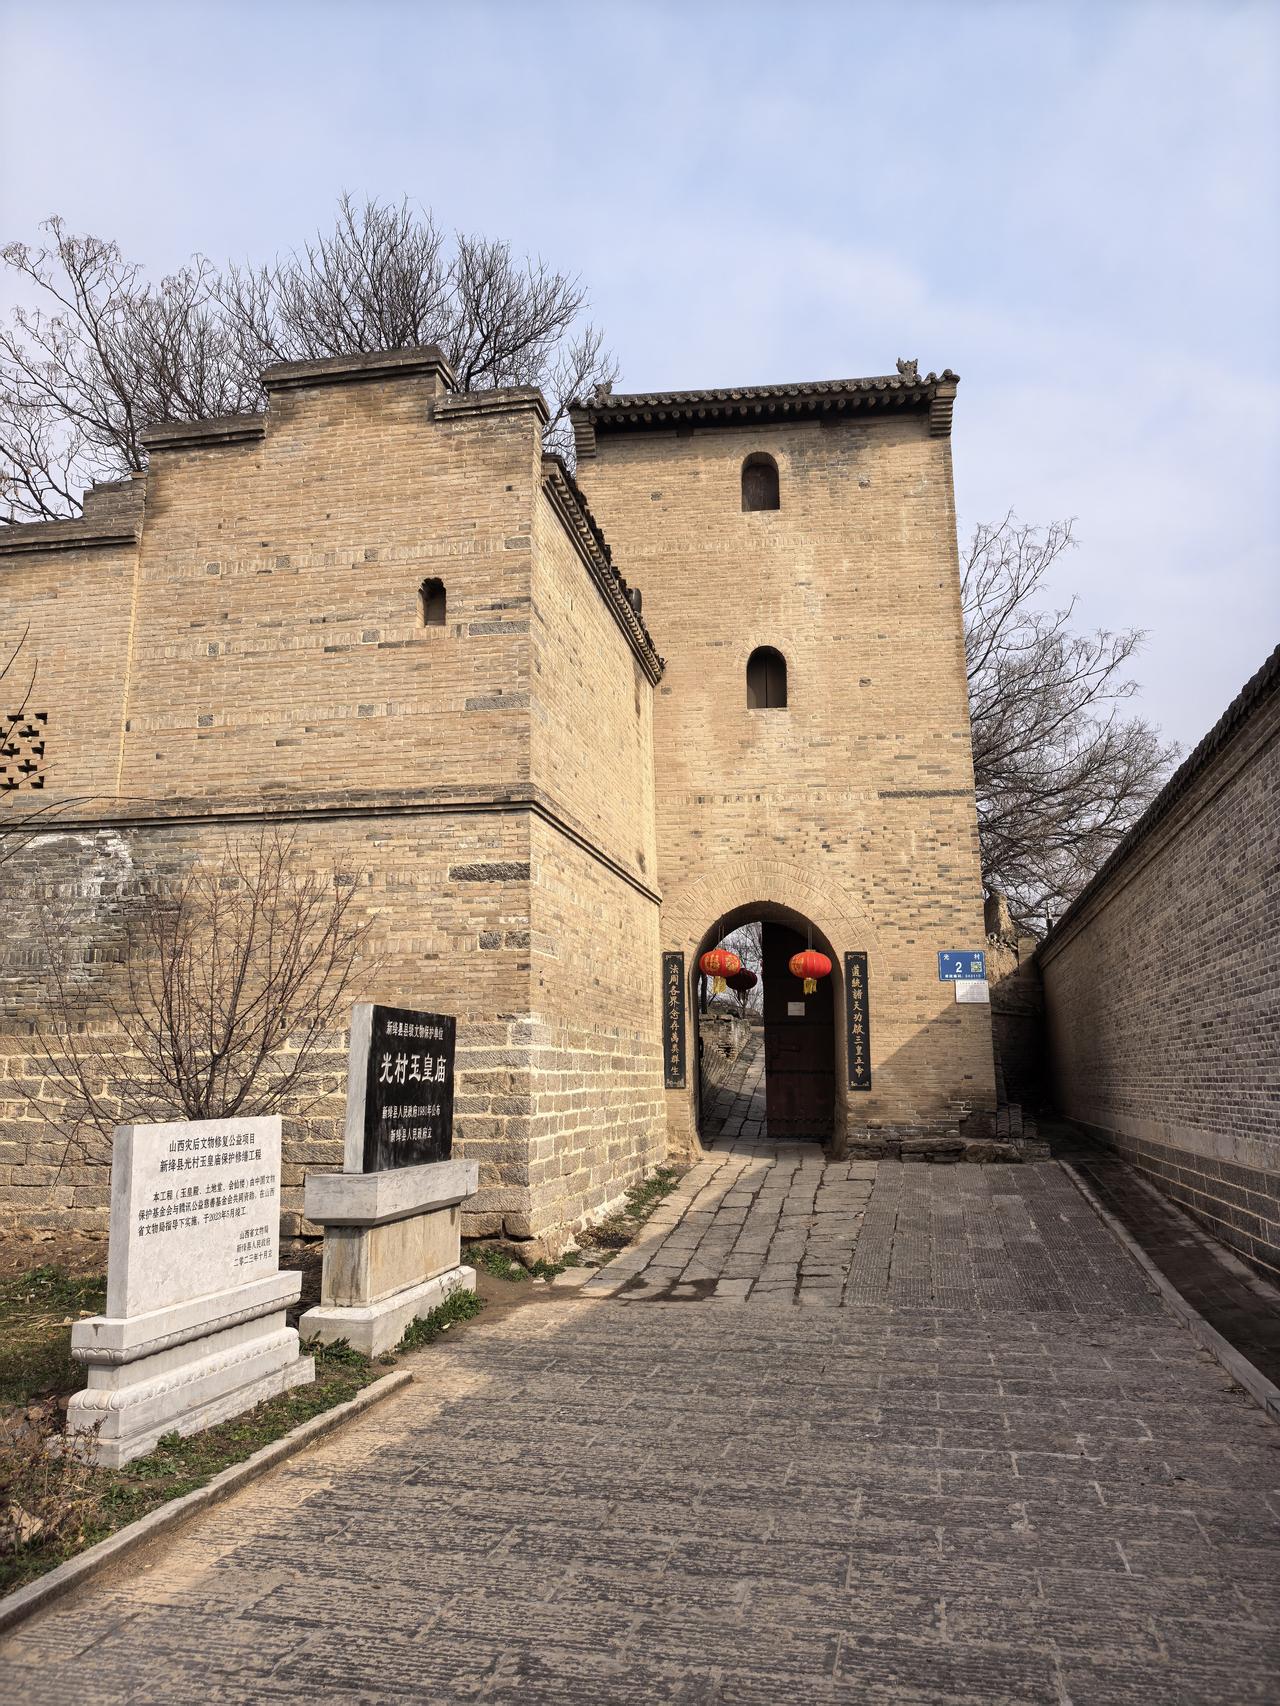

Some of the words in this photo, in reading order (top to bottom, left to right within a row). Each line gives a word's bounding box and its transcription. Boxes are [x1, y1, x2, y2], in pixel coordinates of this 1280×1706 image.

[955, 961, 963, 973] 2
[379, 1052, 447, 1085] 光村玉皇庙
[169, 1133, 255, 1153] 山西灾后文物修复公益项目
[390, 1126, 432, 1143] 新绛县人民政府立
[159, 1148, 262, 1173] 新绛县光村玉皇庙保护修缮工程
[239, 1224, 269, 1240] 山西省文物局
[236, 1237, 271, 1253] 新绛县人民政府
[233, 1249, 273, 1266] 二零二三年十月立
